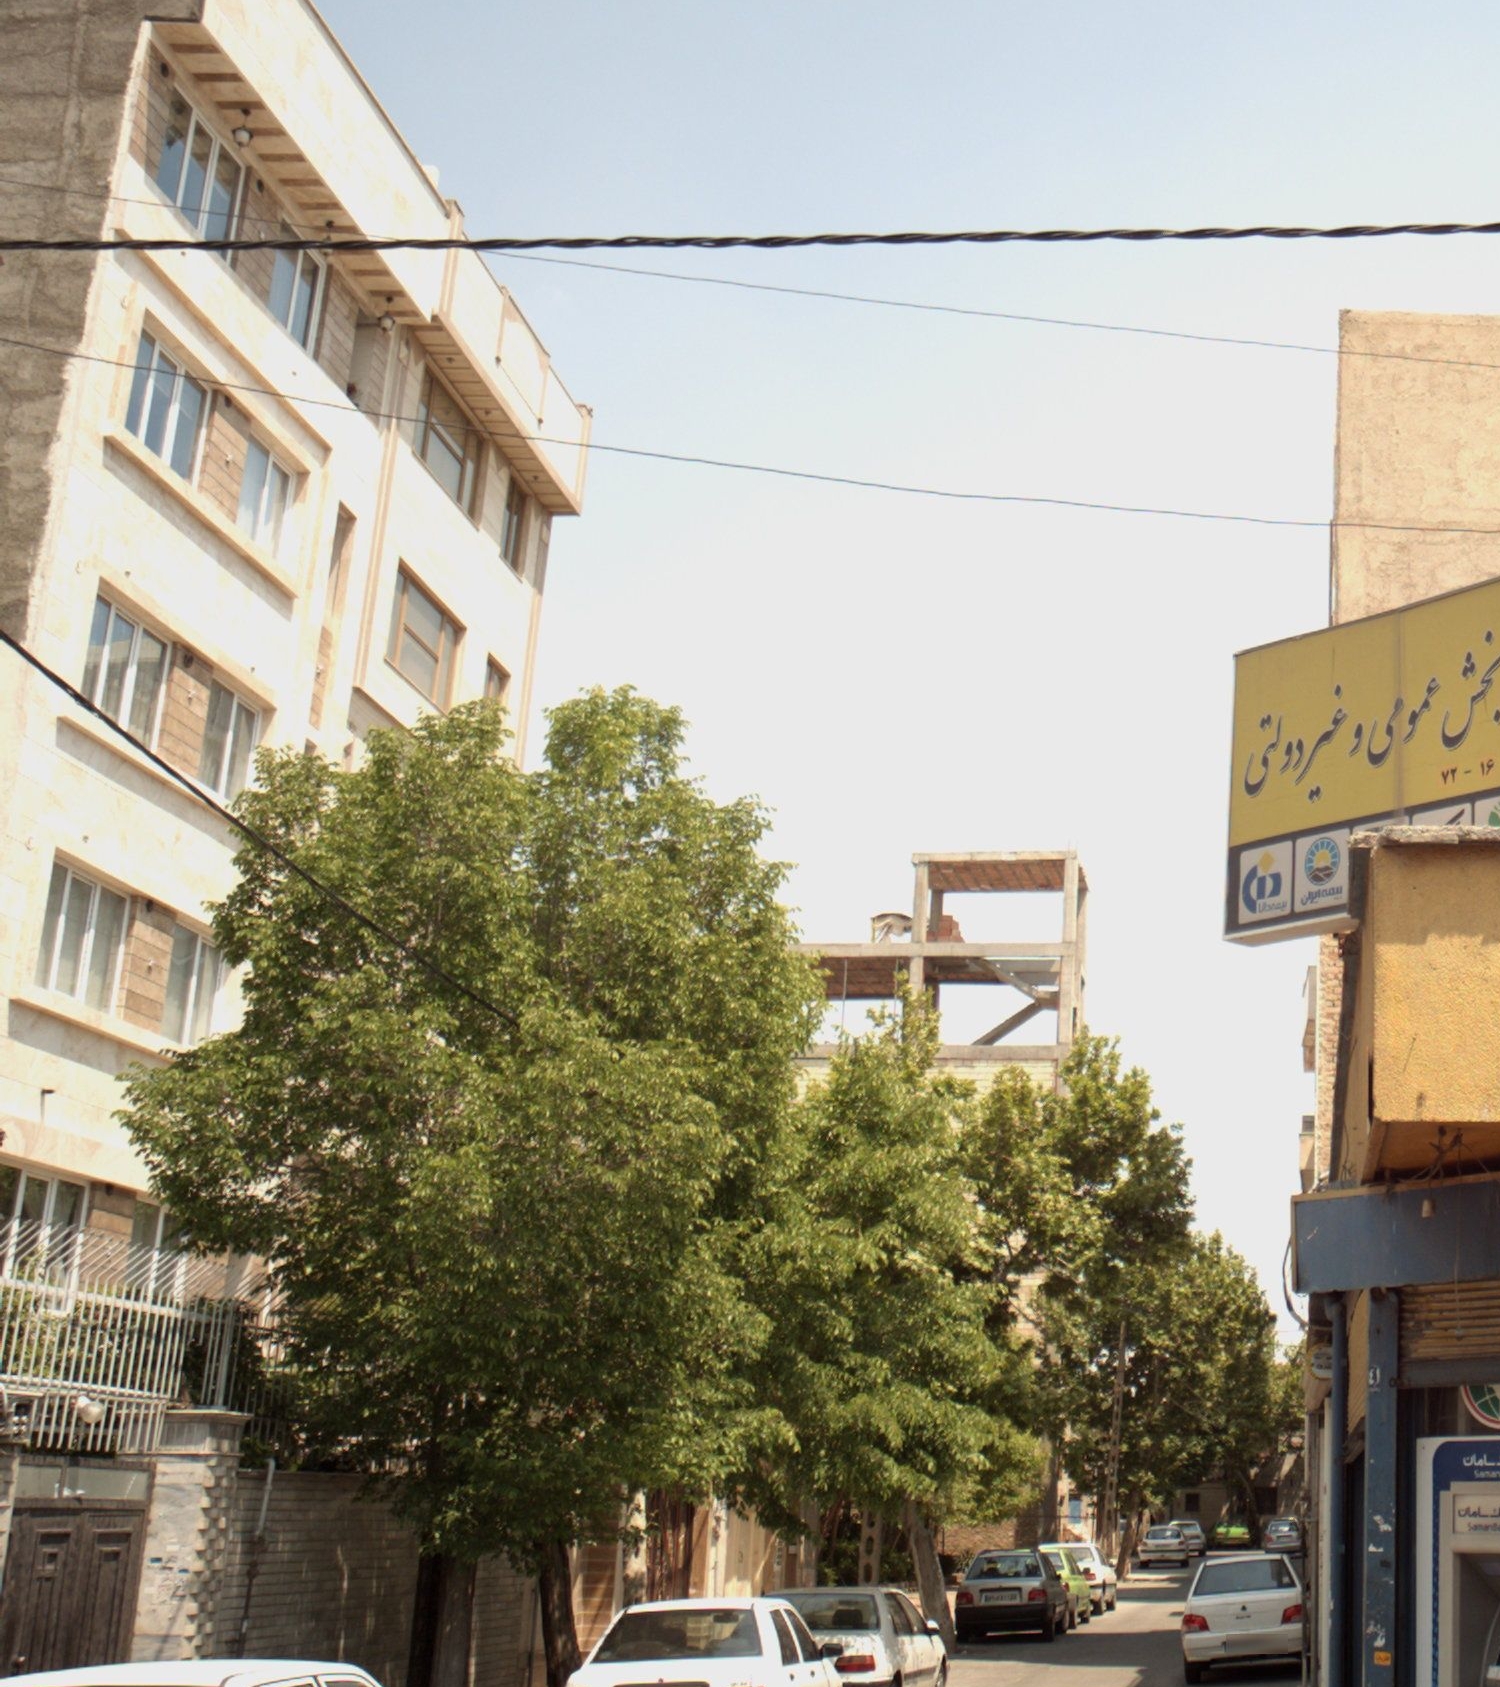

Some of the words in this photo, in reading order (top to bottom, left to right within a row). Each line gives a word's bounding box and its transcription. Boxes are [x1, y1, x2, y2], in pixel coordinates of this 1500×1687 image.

[1349, 722, 1364, 757] و
[1367, 677, 1440, 768] عمومی
[1463, 1453, 1496, 1467] سامان
